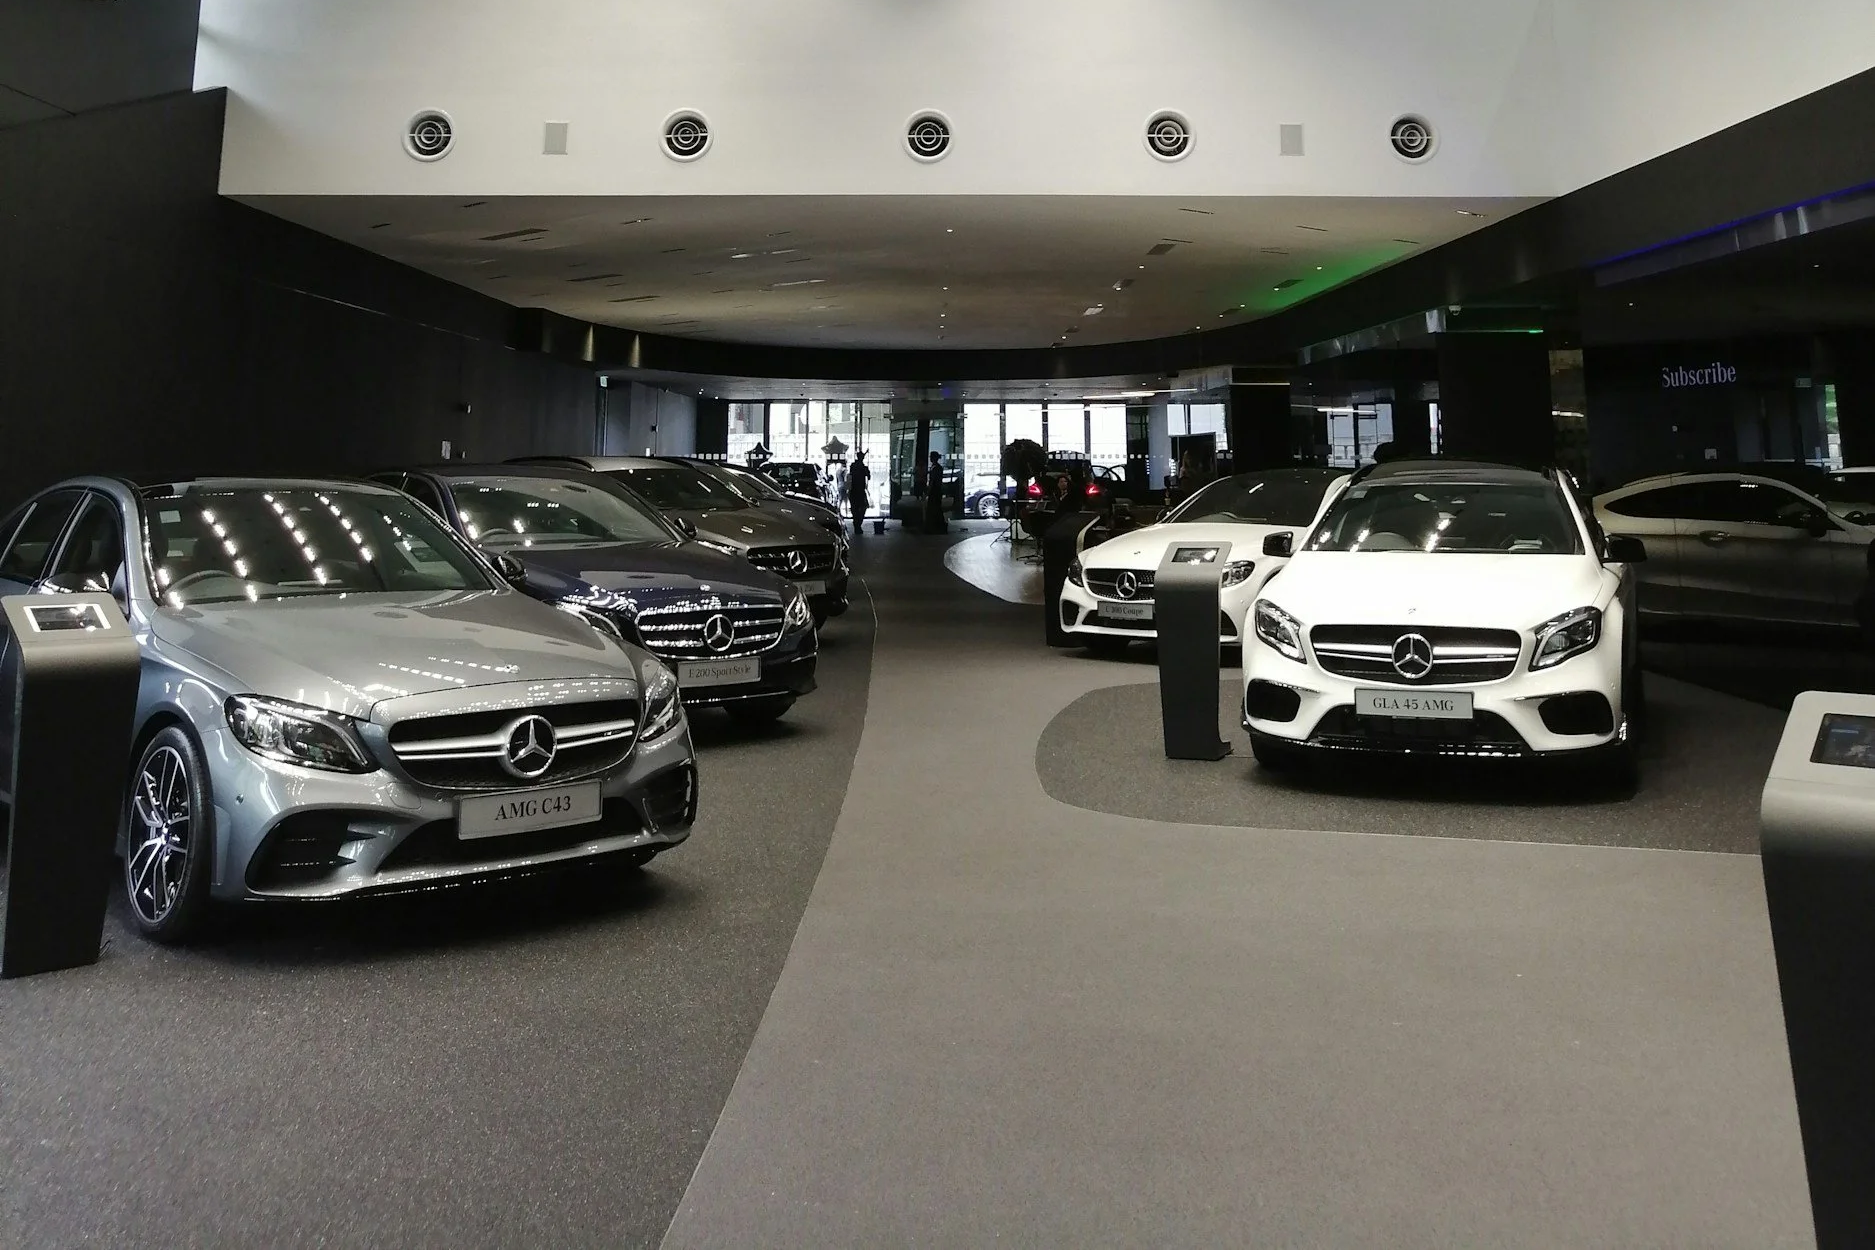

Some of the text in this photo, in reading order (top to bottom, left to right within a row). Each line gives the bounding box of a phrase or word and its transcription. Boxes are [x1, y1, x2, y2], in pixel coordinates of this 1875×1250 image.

[1662, 361, 1737, 388] Subscribe
[688, 668, 694, 679] E
[695, 668, 710, 678] 200
[1373, 697, 1454, 711] GLA 45 AMG
[493, 795, 571, 821] AMG C43
